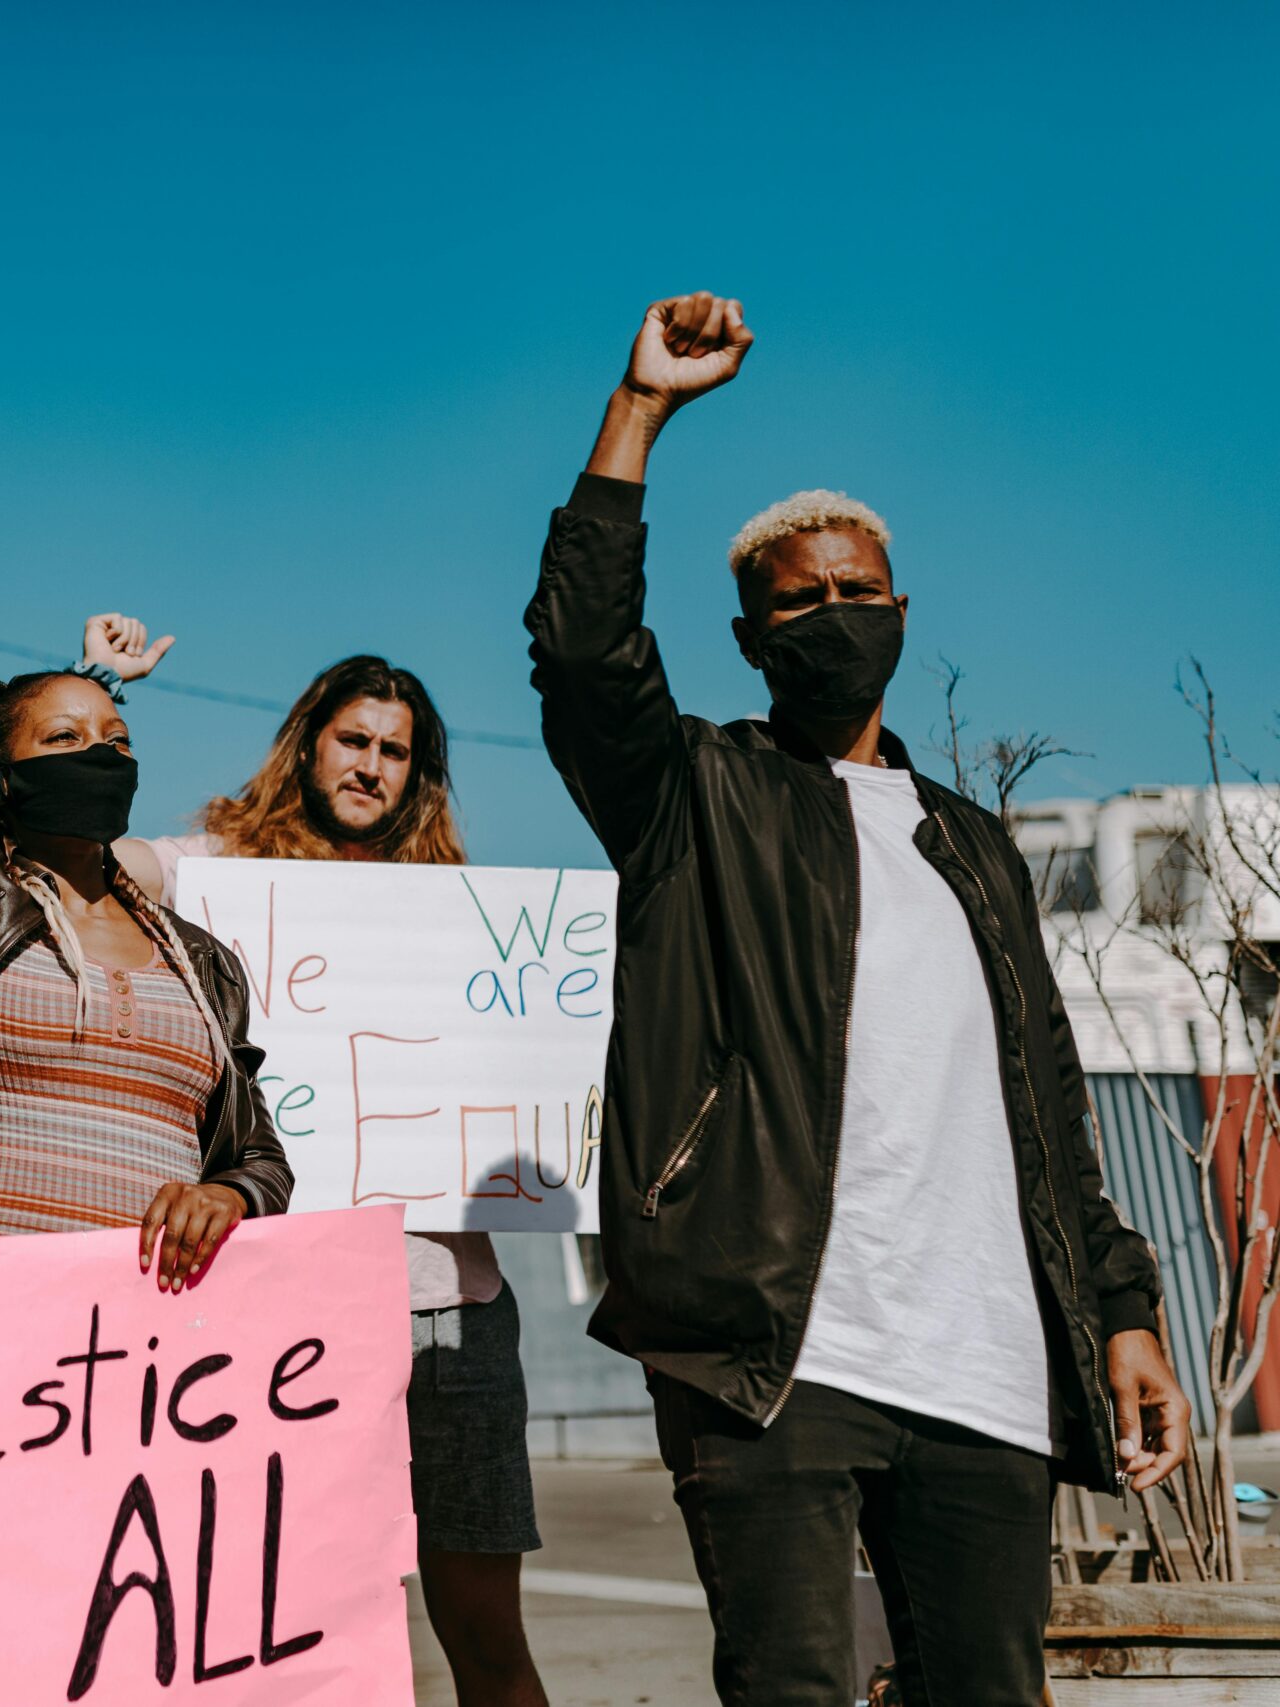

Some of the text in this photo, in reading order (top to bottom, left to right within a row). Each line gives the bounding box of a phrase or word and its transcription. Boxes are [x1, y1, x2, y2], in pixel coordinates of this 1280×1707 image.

[461, 869, 607, 963] We
[466, 962, 602, 1017] are
[349, 1031, 603, 1206] EQUA
[67, 1451, 324, 1702] ALL
